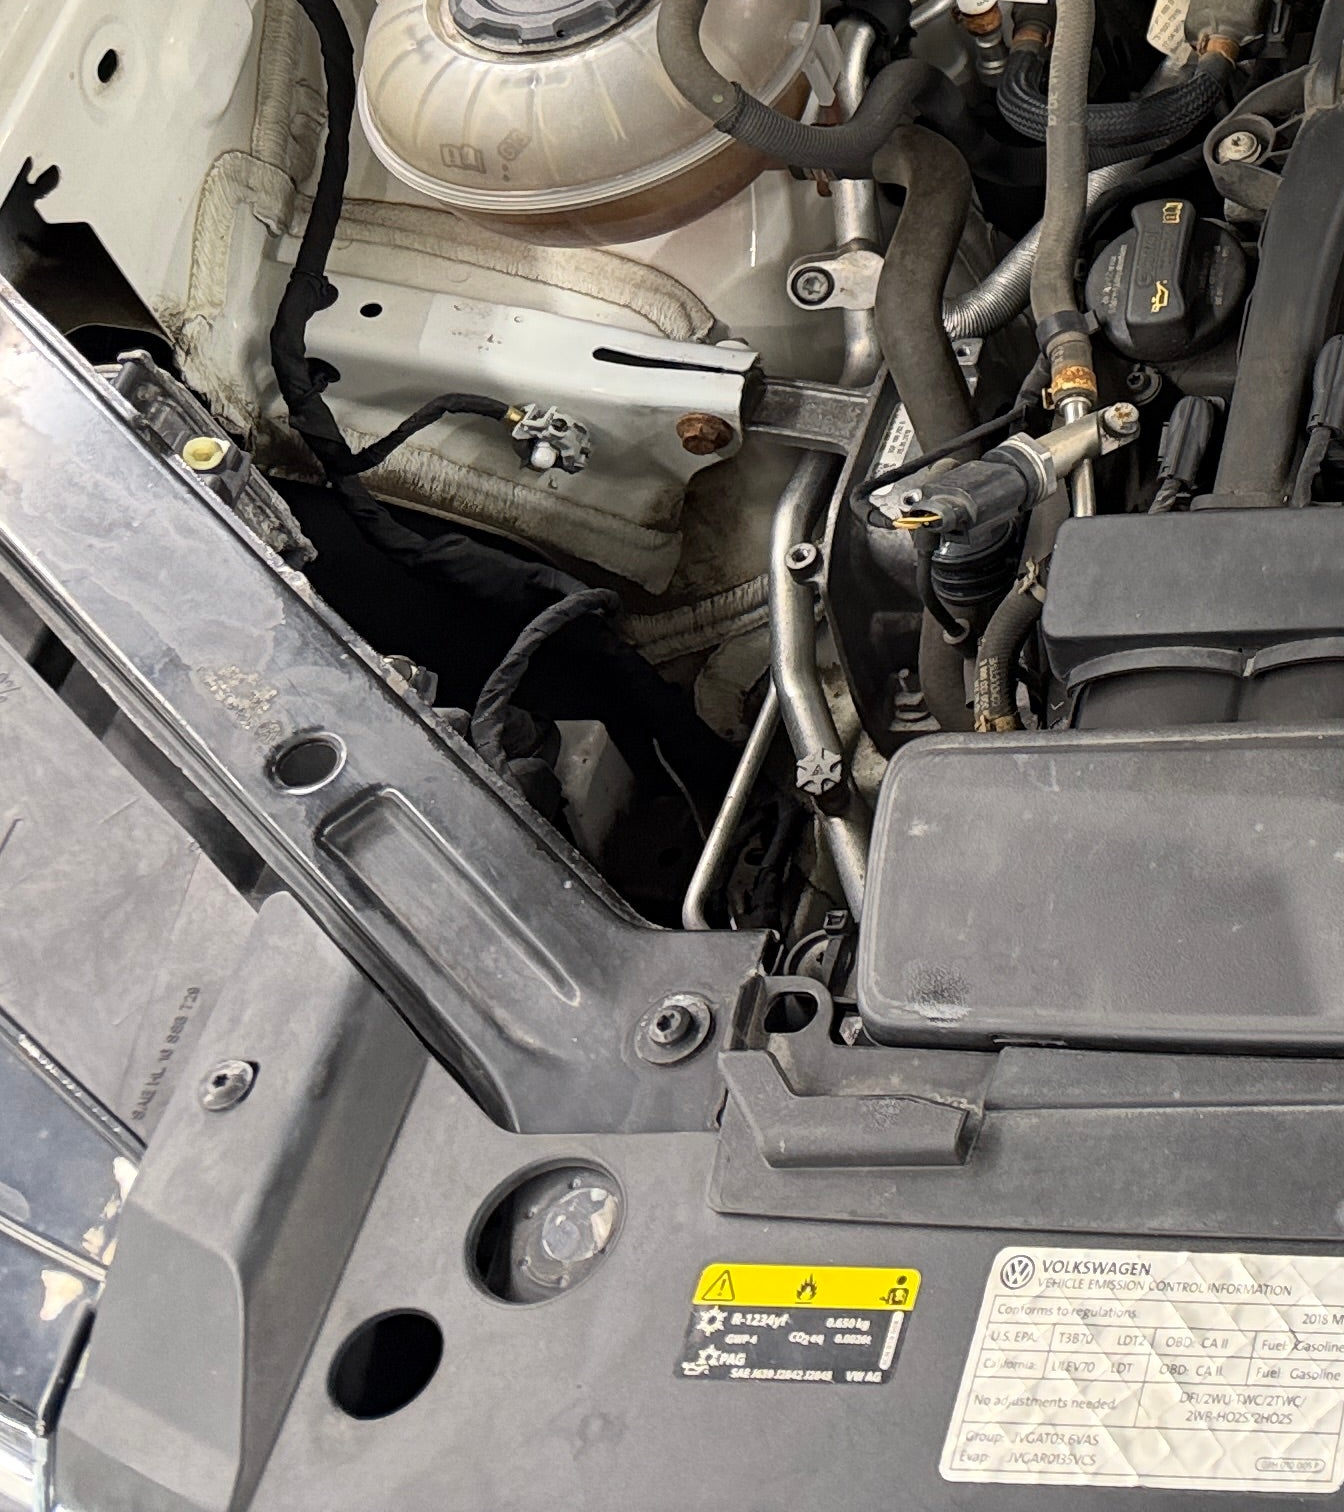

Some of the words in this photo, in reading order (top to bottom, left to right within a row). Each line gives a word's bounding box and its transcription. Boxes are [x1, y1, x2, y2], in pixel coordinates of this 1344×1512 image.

[1042, 1260, 1152, 1276] VOLKSWAGEN
[1038, 1277, 1085, 1290] VEHICLE
[1087, 1278, 1145, 1291] EMISSION
[1149, 1280, 1204, 1294] CONTROL
[1206, 1282, 1293, 1296] INFORMATION
[997, 1303, 1054, 1317] Conforms
[731, 1312, 790, 1329] R-1234yf
[1302, 1313, 1328, 1326] 2018
[1202, 1338, 1218, 1350] CA
[719, 1352, 747, 1367] PAG
[846, 1370, 864, 1382] VW
[864, 1371, 882, 1383] AG
[1290, 1369, 1342, 1382] Gasoline
[973, 1394, 990, 1406] No
[993, 1395, 1068, 1410] adjustments
